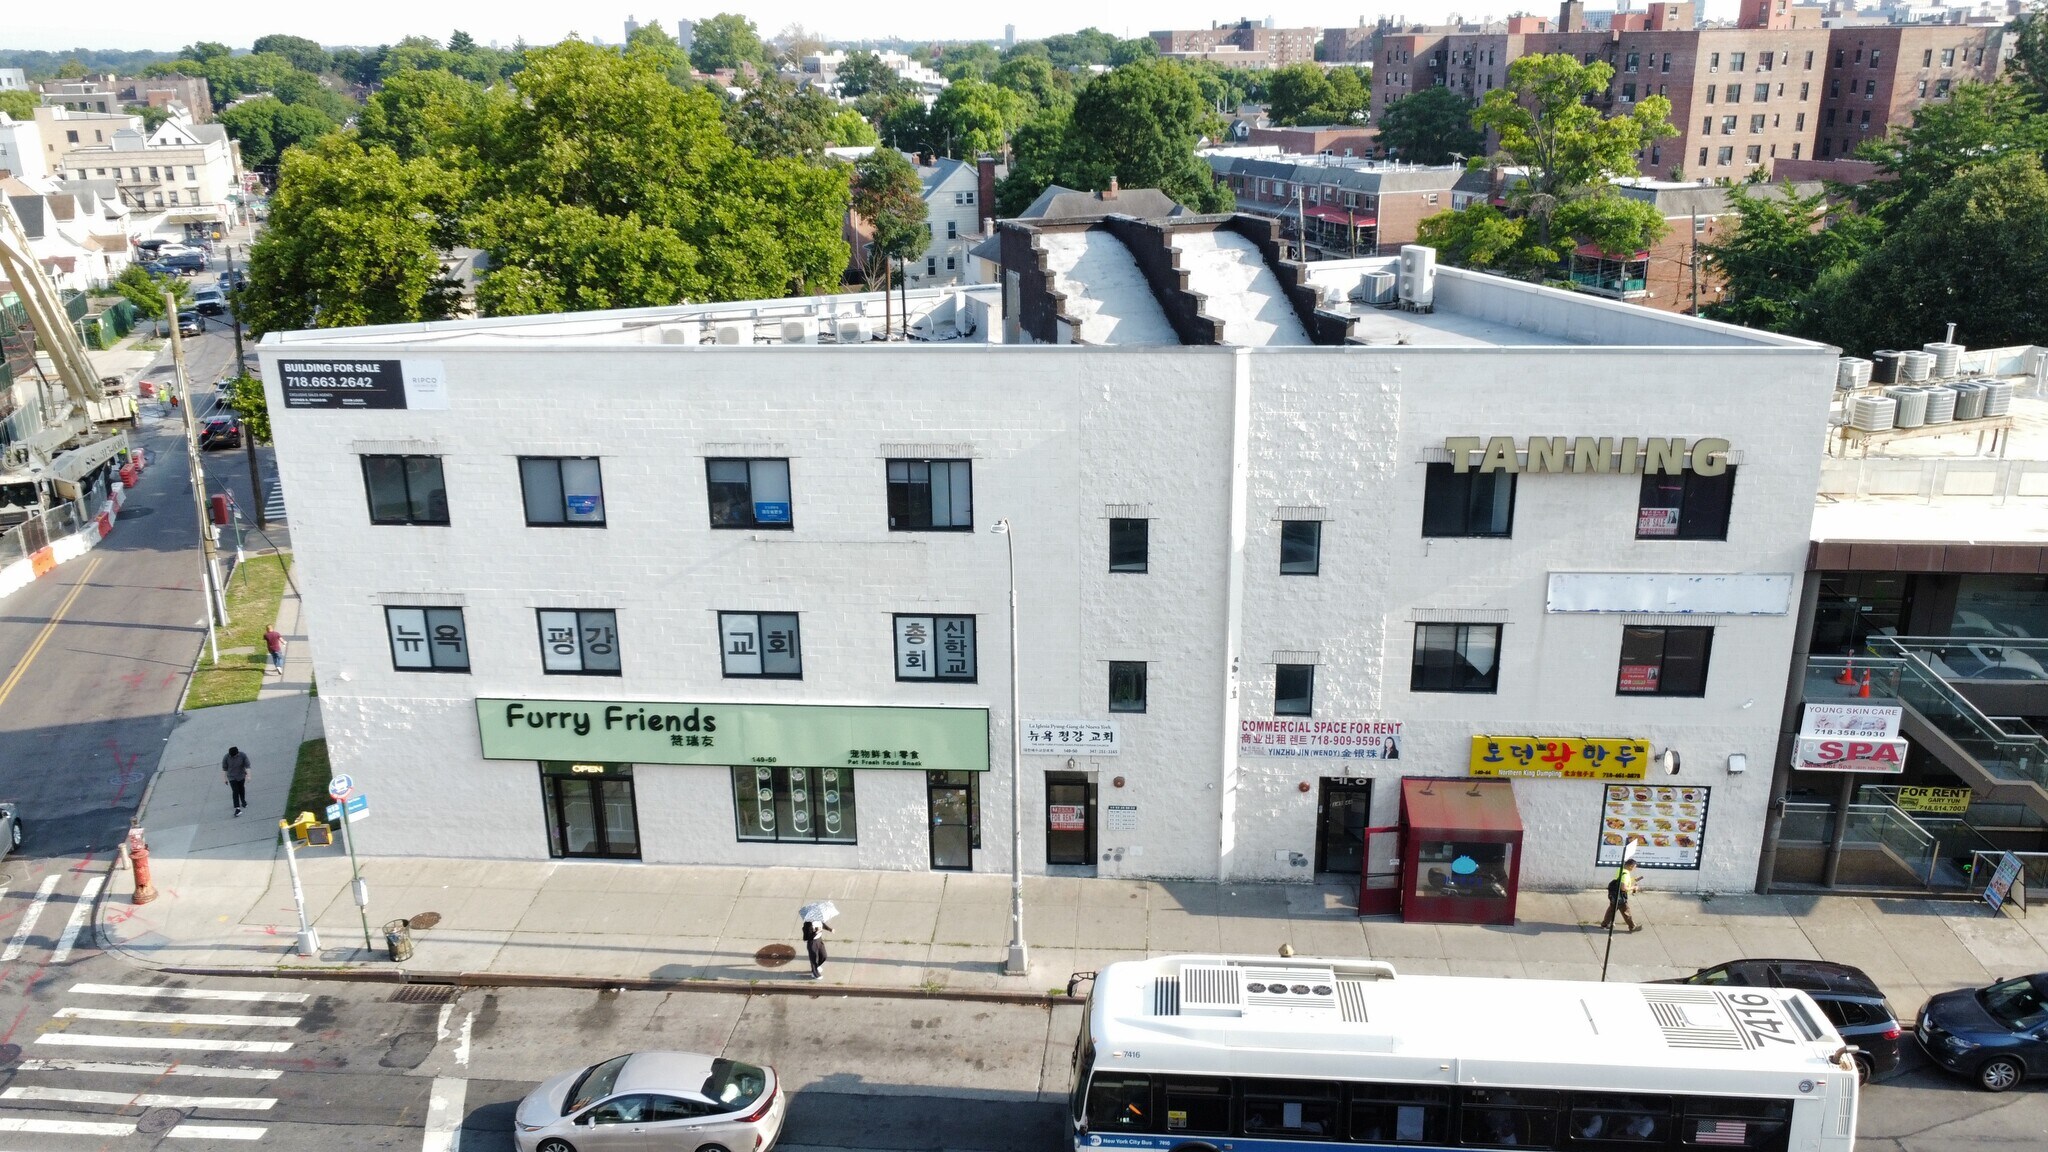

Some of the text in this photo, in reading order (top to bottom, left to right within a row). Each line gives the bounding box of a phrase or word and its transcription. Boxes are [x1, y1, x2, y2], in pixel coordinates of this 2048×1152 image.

[284, 363, 381, 373] BUILDING FOR SALE
[286, 376, 374, 388] 718.663.2642
[1446, 436, 1731, 477] TANNING
[396, 624, 463, 653] 뉴욕
[547, 627, 615, 655] 평강
[728, 630, 794, 659] 교회
[904, 622, 927, 672] 총회
[944, 620, 968, 674] 신학교
[1809, 706, 1899, 716] YOUNG SKIN CARE
[506, 703, 717, 736] Furry Friends
[1241, 720, 1402, 735] COMMERCIAL SPACE FOR RENT
[1814, 728, 1886, 738] 718-358-0930
[1028, 730, 1053, 742] 뉴욕
[1089, 731, 1113, 743] 교회
[1311, 735, 1381, 746] 718-909-9596
[1268, 748, 1296, 756] YINZHU
[1310, 748, 1341, 758] (WENDY)
[1817, 741, 1900, 763] SPA
[571, 764, 604, 773] OPEN
[1522, 769, 1535, 778] King
[1536, 770, 1563, 778] Dumpling
[1900, 787, 1970, 798] FOR RENT
[1728, 993, 1796, 1047] 7416
[1123, 1051, 1141, 1059] 7416
